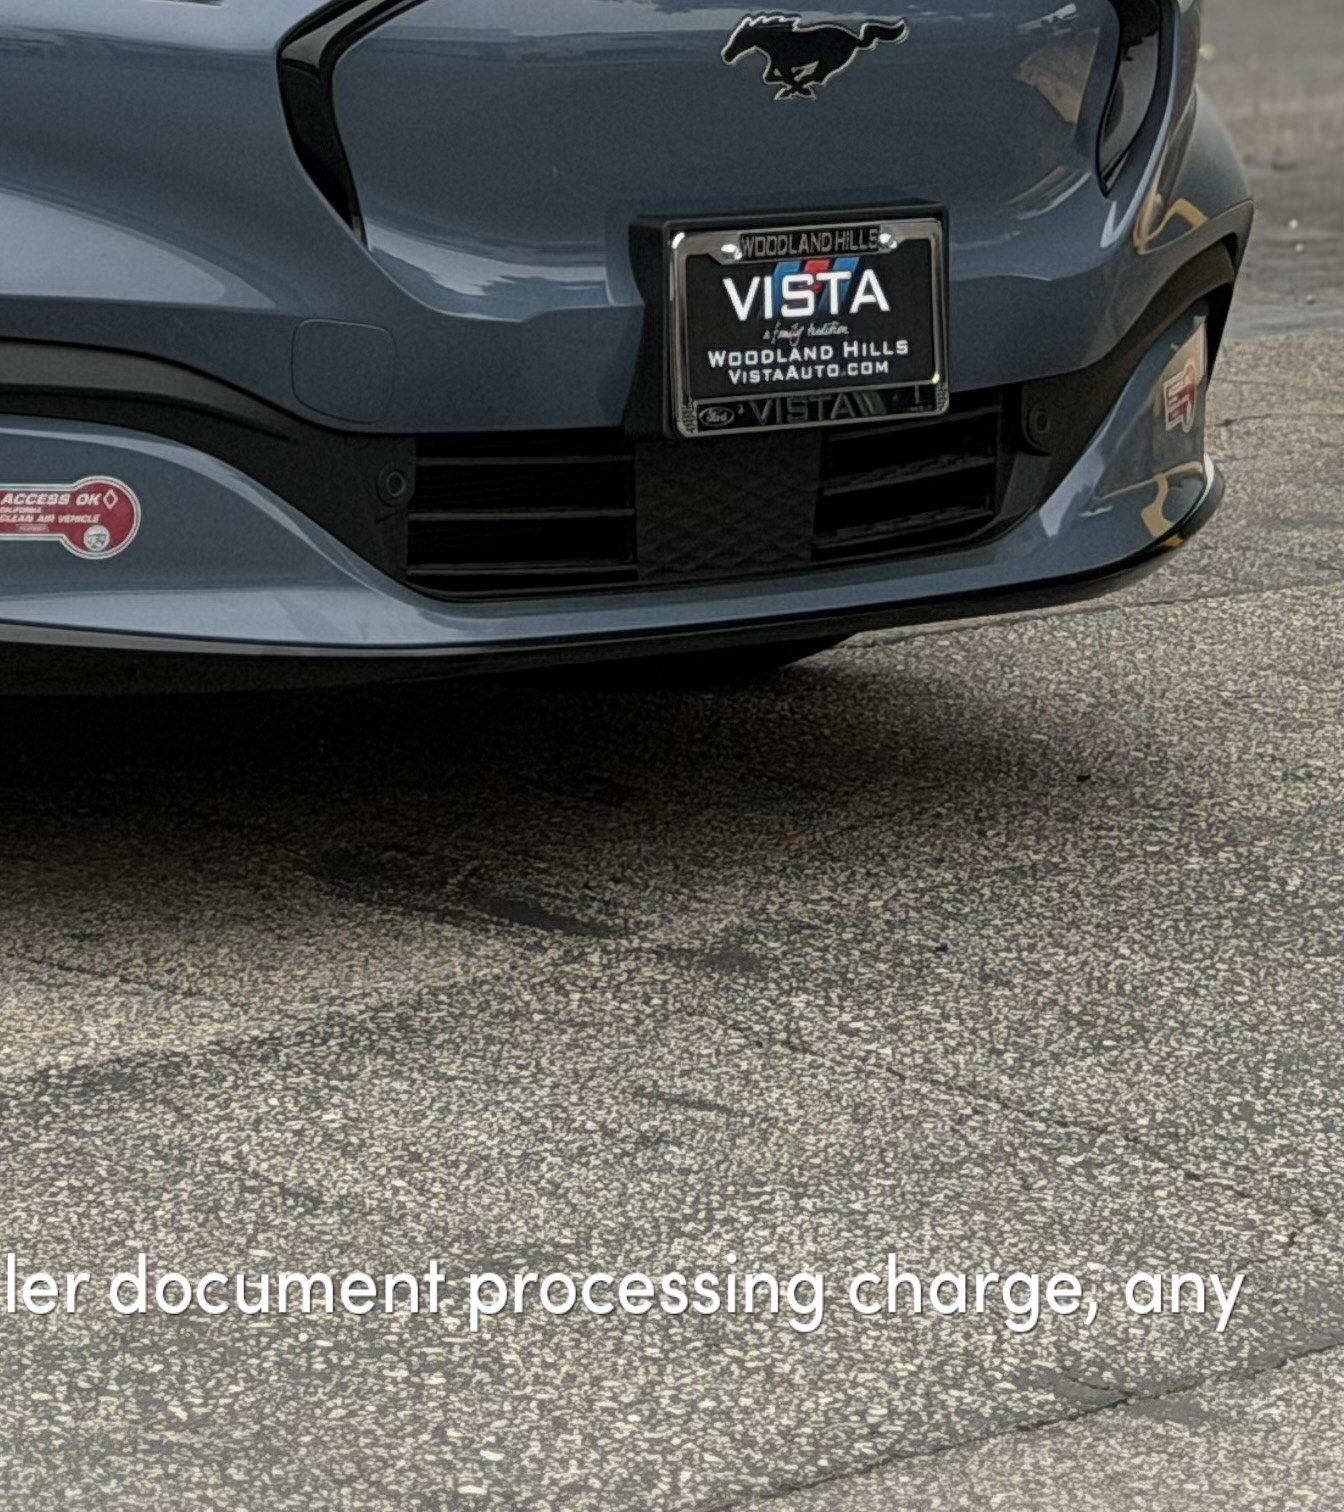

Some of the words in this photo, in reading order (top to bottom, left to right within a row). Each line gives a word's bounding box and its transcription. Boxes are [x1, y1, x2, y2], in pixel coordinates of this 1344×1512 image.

[741, 232, 831, 257] WOODLAND
[835, 229, 879, 252] HILLS
[722, 269, 890, 322] VISTA
[708, 345, 833, 368] WOODLAND
[843, 340, 909, 359] HILLS
[728, 361, 889, 385] VISTAAUTO.COM
[749, 393, 855, 425] VISTA
[0, 493, 70, 505] ACCESS
[75, 493, 102, 506] OK
[0, 514, 34, 523] CLEAN
[37, 514, 55, 523] AIR
[58, 514, 101, 524] VEHICLE
